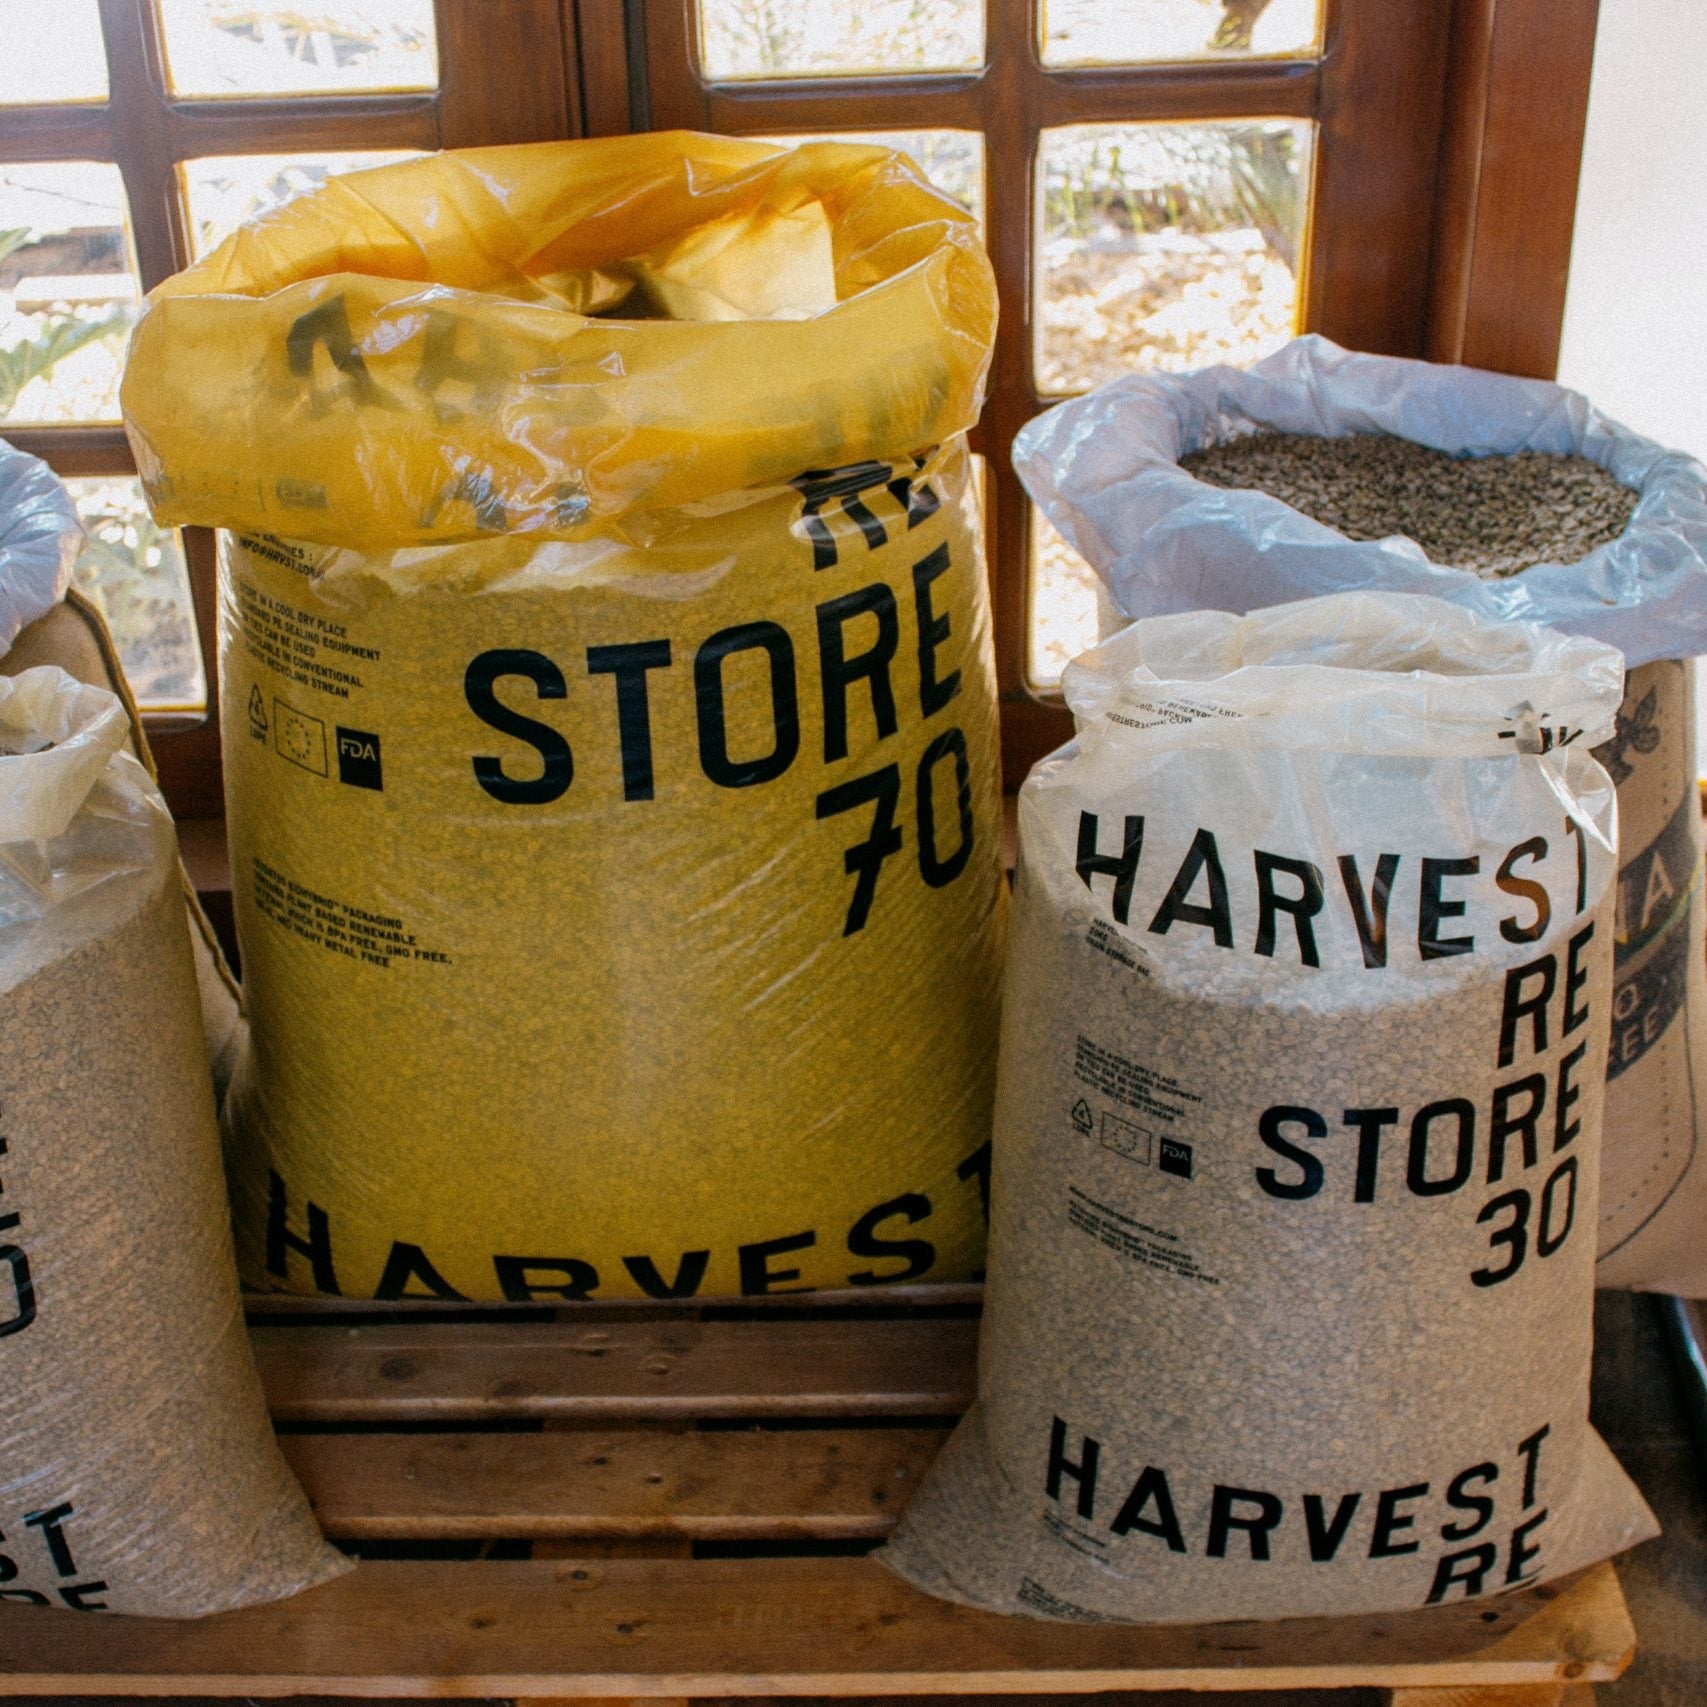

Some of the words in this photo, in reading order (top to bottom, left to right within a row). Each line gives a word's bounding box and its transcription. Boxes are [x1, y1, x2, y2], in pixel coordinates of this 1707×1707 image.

[268, 598, 273, 608] A
[275, 600, 295, 620] COOL
[298, 611, 315, 626] DRY
[317, 619, 347, 638] PLACE
[280, 635, 291, 648] BE
[293, 643, 315, 658] USED
[285, 622, 319, 644] SEALING
[323, 637, 381, 661] EQUIPMENT
[267, 656, 309, 685] RECYCLING
[311, 677, 349, 699] STREAM
[293, 656, 364, 688] CONVENTIONAL
[463, 541, 963, 805] STORE
[340, 738, 377, 762] FDA
[816, 727, 974, 938] 70
[1075, 810, 1590, 970] HARVEST
[316, 907, 346, 927] BASED
[350, 920, 417, 946] RENEWABLE
[343, 905, 403, 929] PACKAGING
[361, 951, 391, 968] FREE
[386, 944, 410, 958] GMO
[1497, 920, 1595, 1070] RE
[1255, 1038, 1586, 1203] STORE
[1162, 1143, 1190, 1162] FDA
[1470, 1155, 1579, 1288] 30
[1045, 1416, 1550, 1562] HARVEST
[1425, 1508, 1548, 1606] RE
